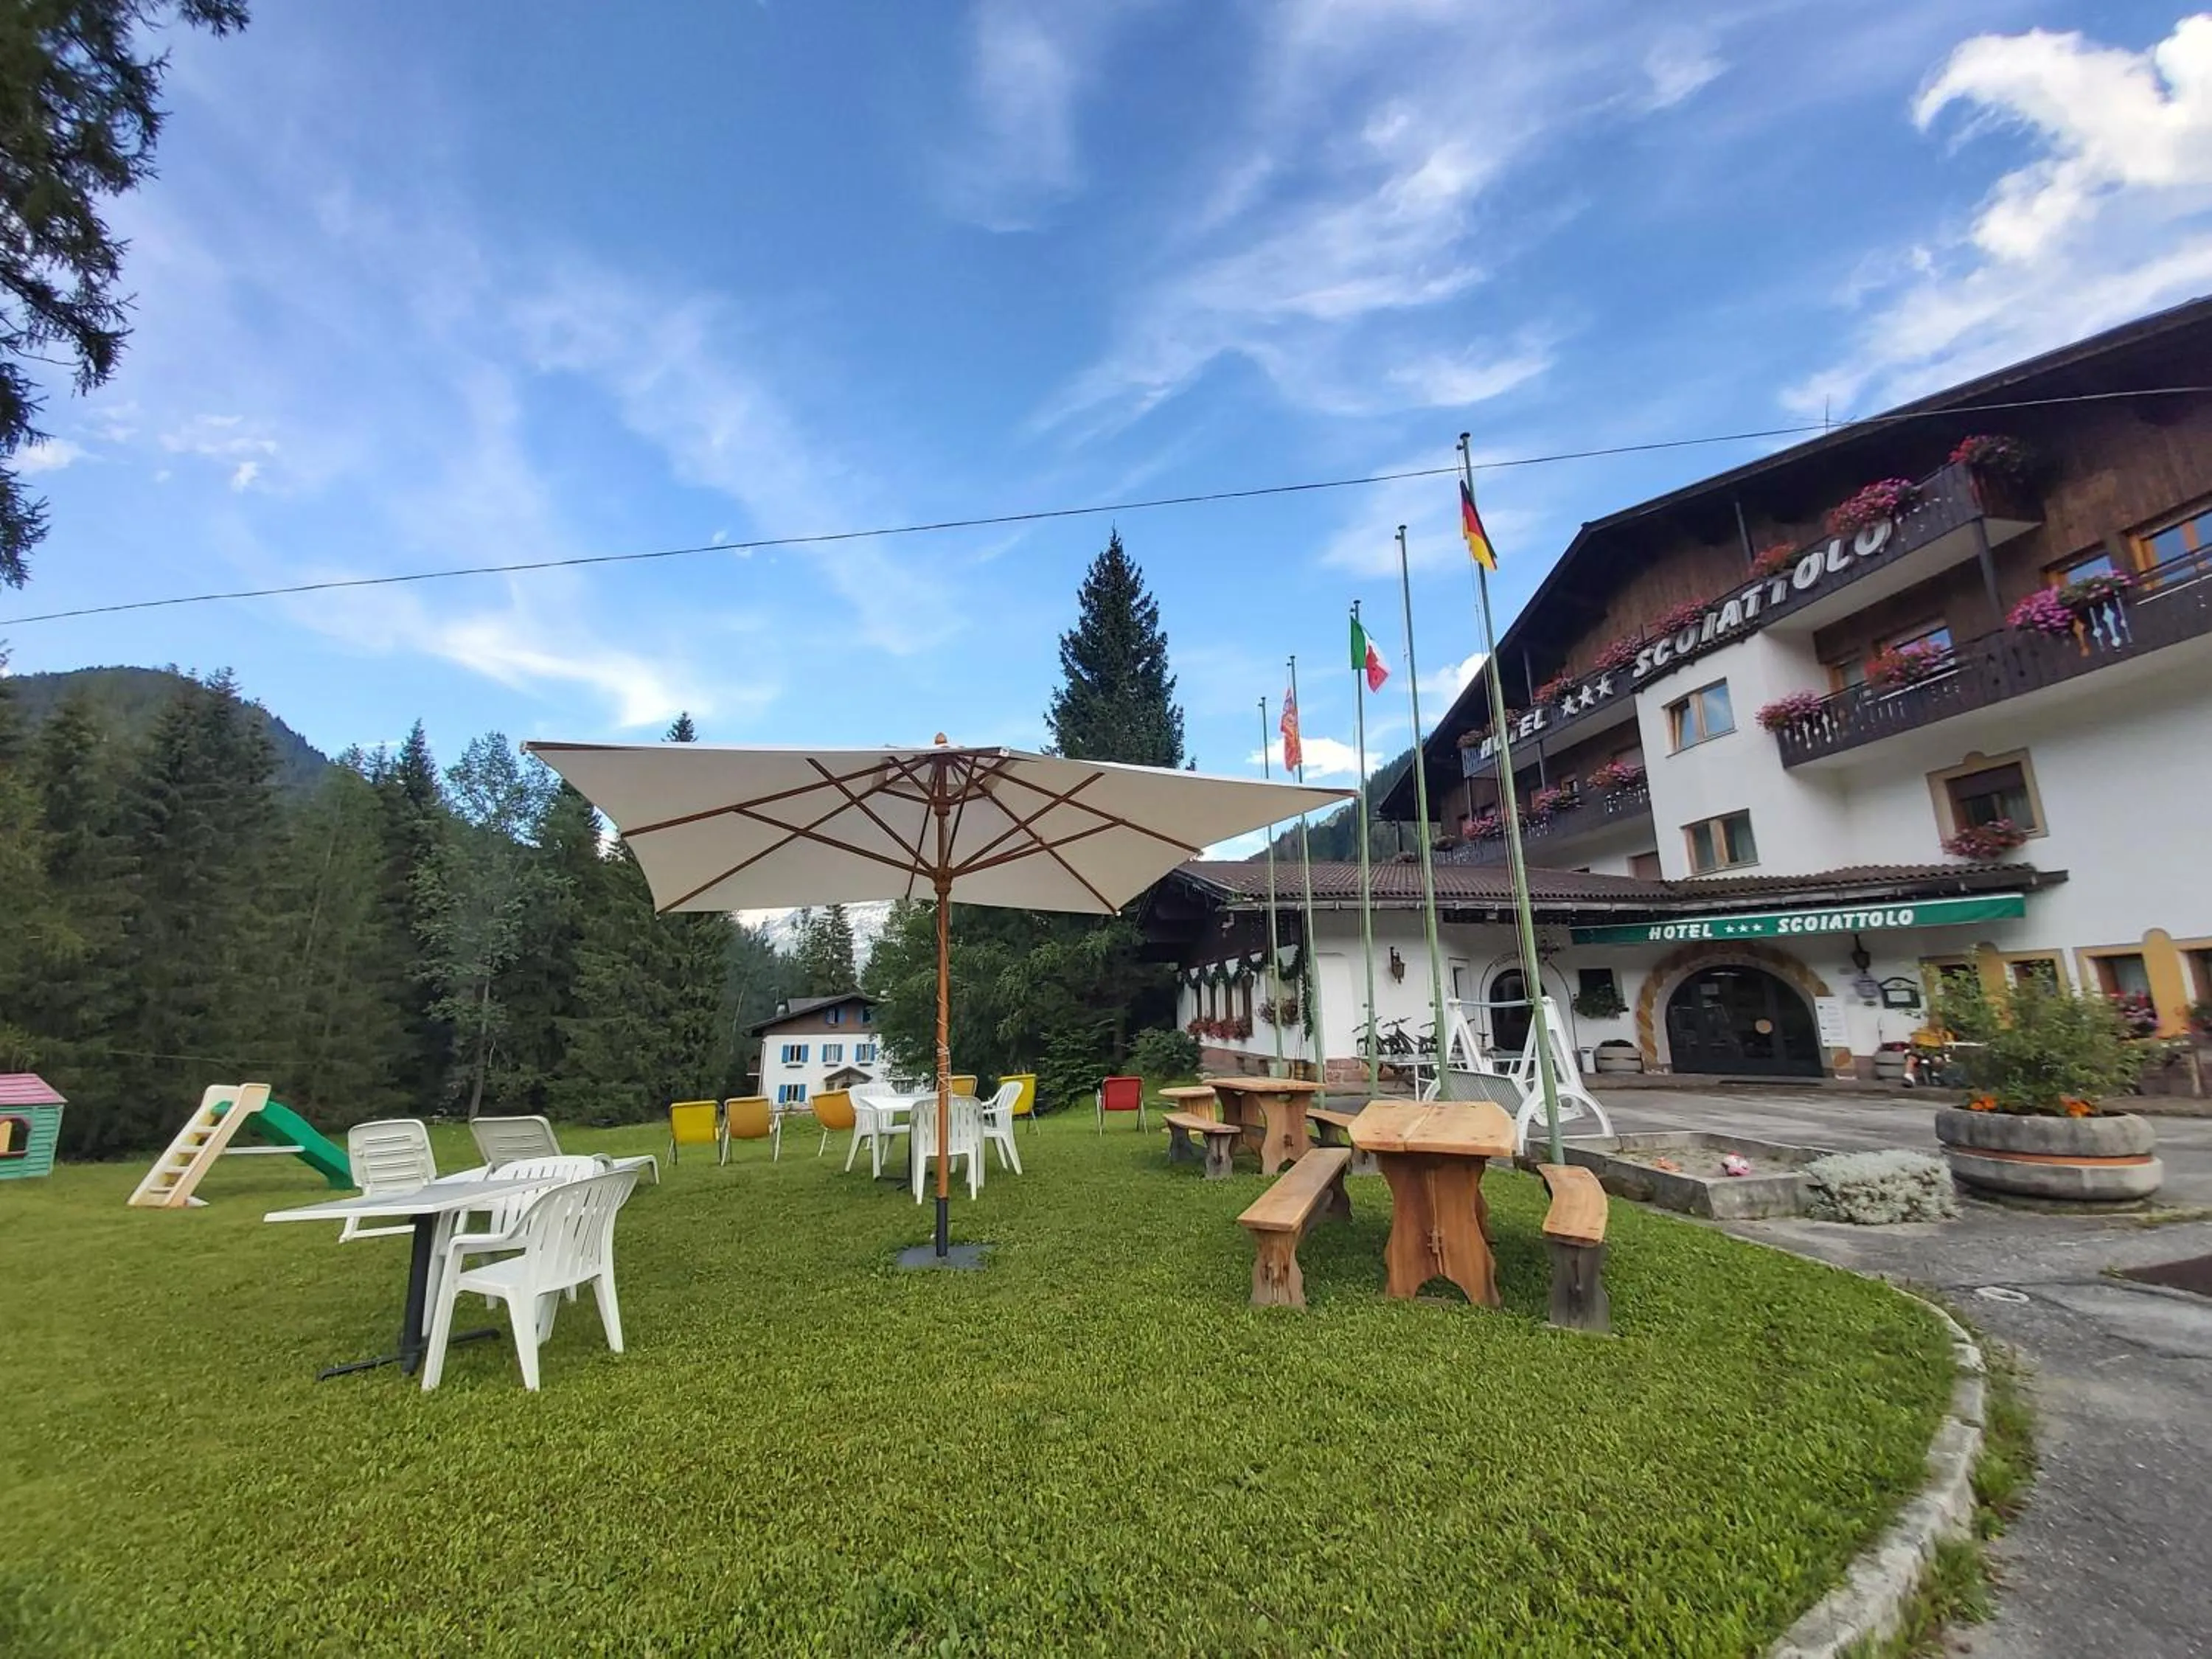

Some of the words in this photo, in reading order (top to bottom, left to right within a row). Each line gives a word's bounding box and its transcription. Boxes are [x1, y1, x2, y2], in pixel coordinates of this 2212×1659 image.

[1632, 521, 1892, 678] SCOIATTOLO
[1649, 924, 1713, 940] HOTEL
[1778, 909, 1914, 933] SCOIATTOLO
